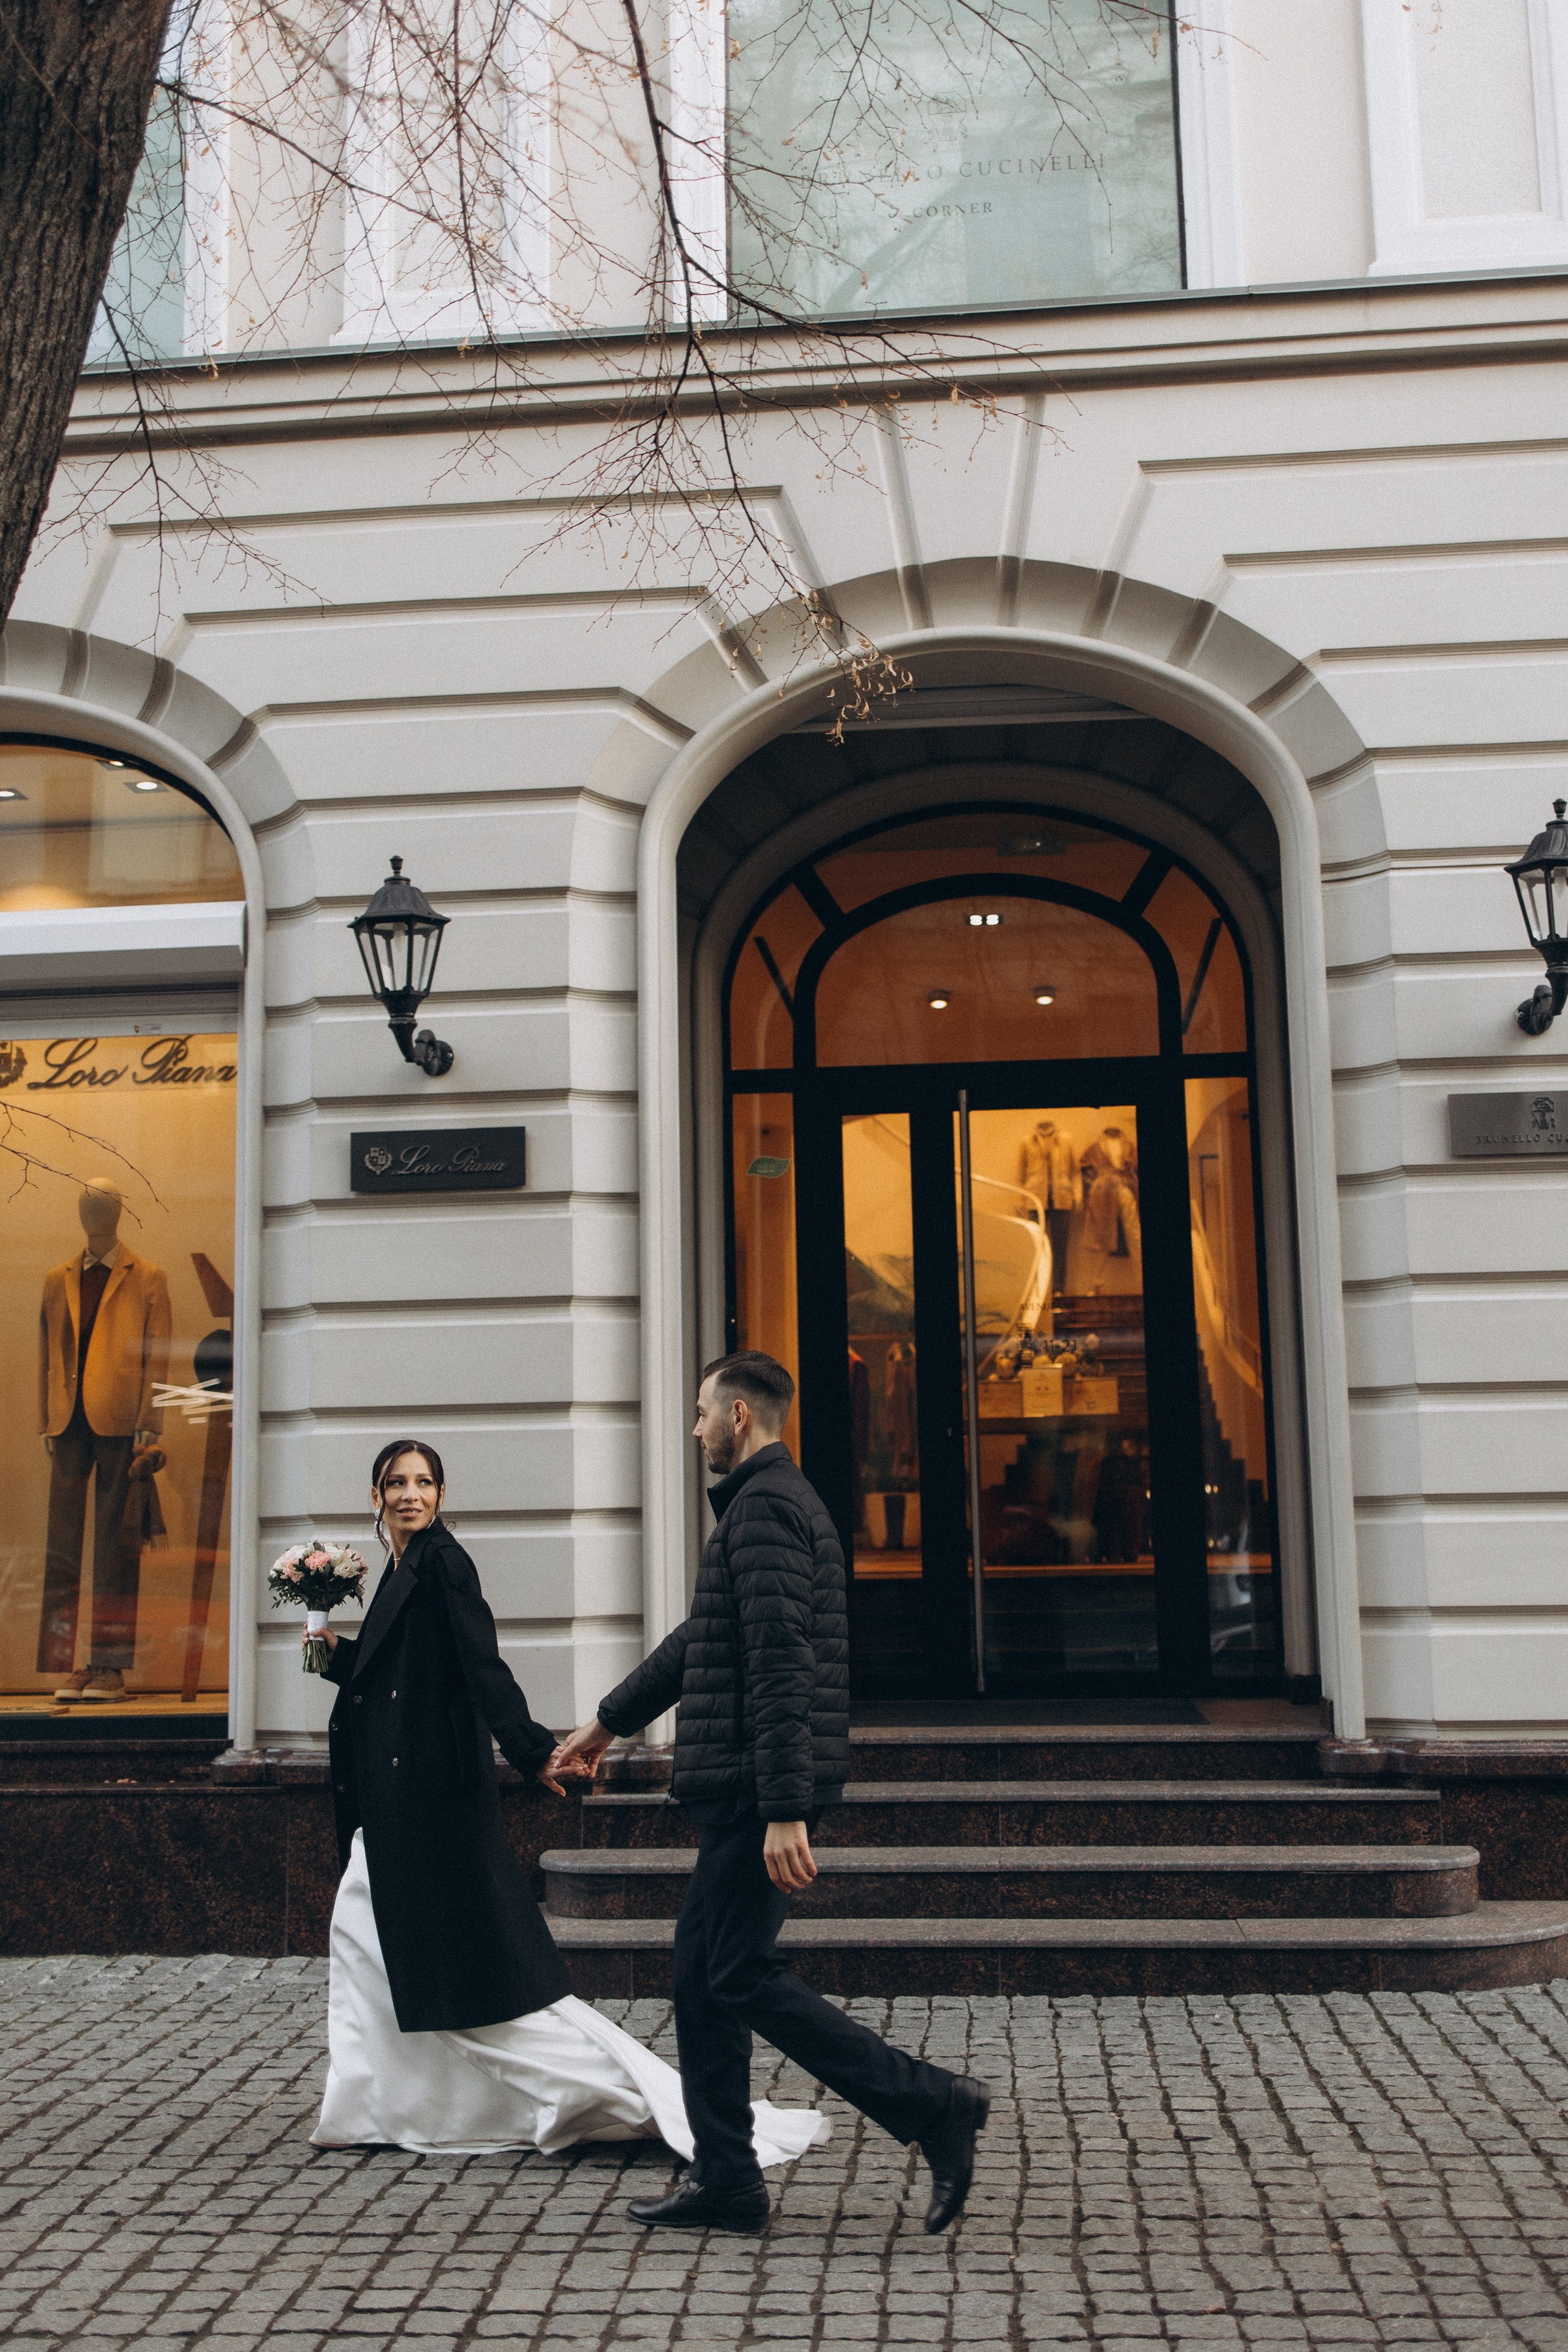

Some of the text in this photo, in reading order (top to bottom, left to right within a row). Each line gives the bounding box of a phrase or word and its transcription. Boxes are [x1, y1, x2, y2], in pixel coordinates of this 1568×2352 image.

[959, 154, 1103, 178] CUCINELLI
[913, 202, 993, 218] CORNER
[27, 1034, 238, 1090] Loro Piana
[391, 1143, 507, 1175] Loro Piana
